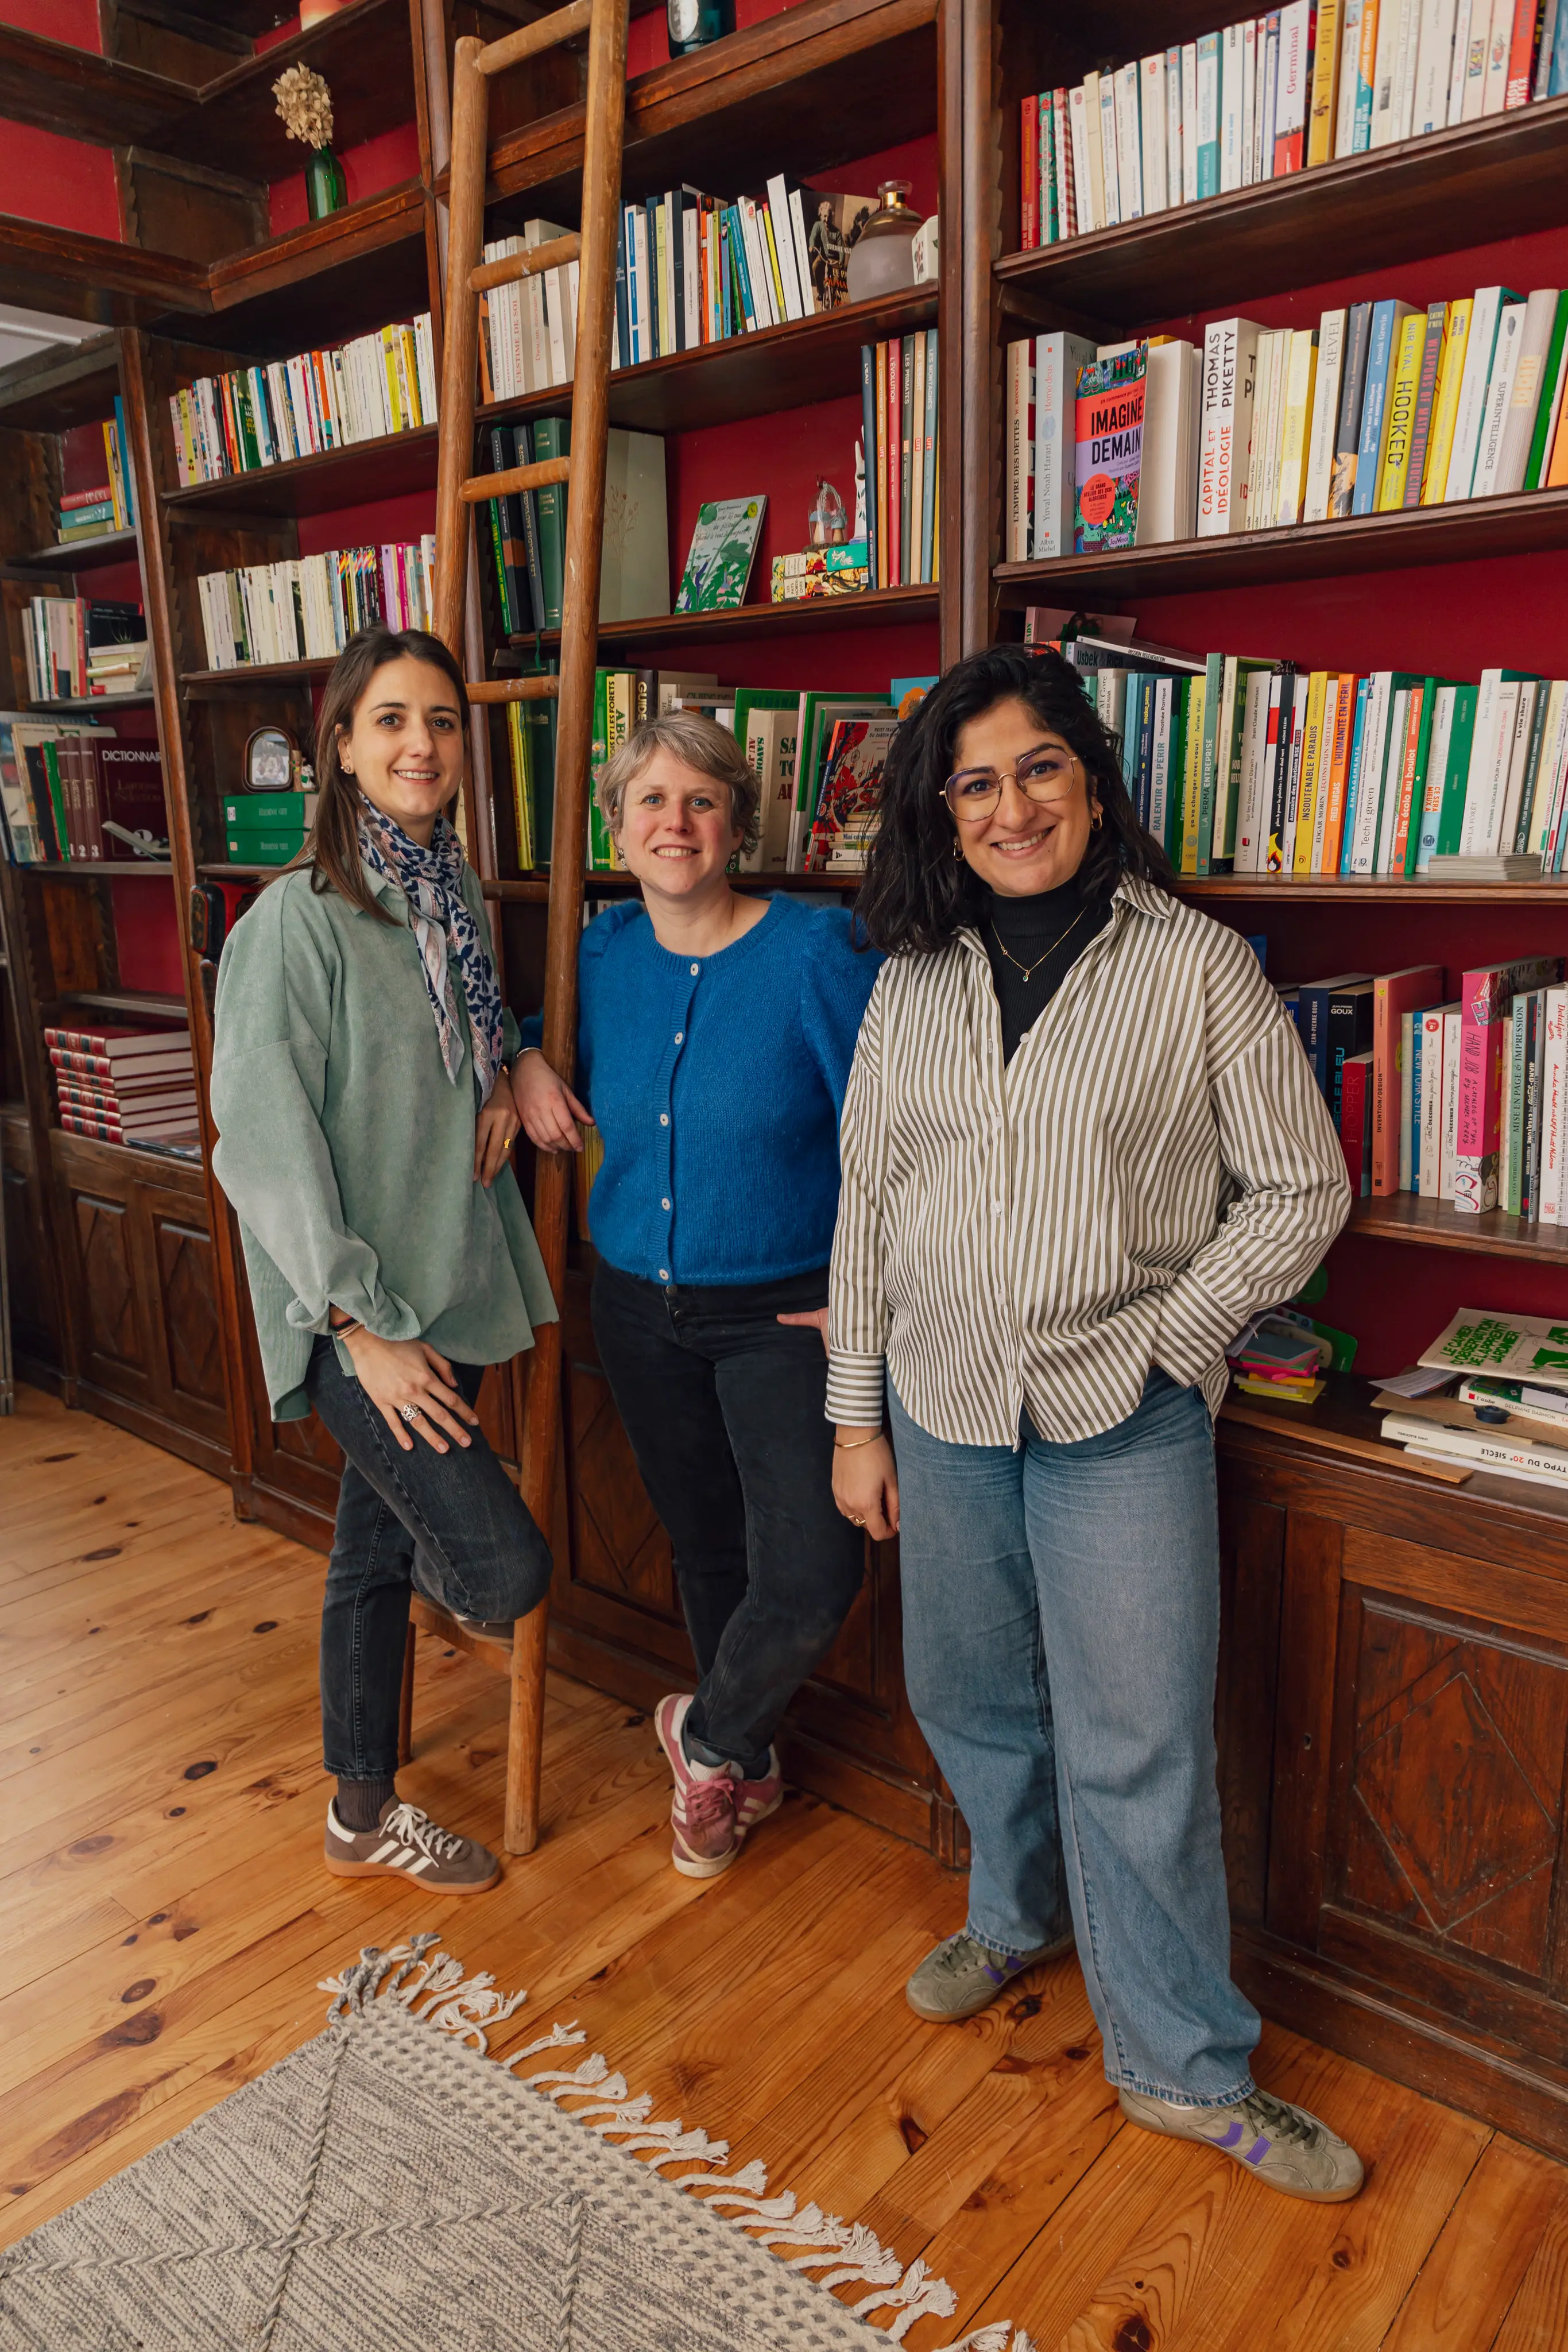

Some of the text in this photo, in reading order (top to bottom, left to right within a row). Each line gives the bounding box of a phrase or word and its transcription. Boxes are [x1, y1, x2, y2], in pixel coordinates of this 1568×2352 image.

[1286, 25, 1299, 94] Germinal
[514, 319, 520, 334] DE
[1326, 317, 1340, 366] REVEL
[1375, 314, 1388, 366] Anouk Grevin
[1206, 333, 1220, 411] THOMAS
[1222, 331, 1235, 408] PIKETTY
[1044, 365, 1053, 412] Homo deus
[1387, 323, 1416, 464] NIR EYAL HOOKED
[1485, 341, 1511, 470] SUPERINTELLIGENCE BOSTROM
[1091, 394, 1143, 436] IMAGINE
[1315, 378, 1331, 475] L'obsession anti-américaine
[1406, 338, 1438, 504] WEAPONS OF MATH DESTRUCTION
[1092, 426, 1141, 465] DEMAIN
[1043, 443, 1052, 521] Yuval Noah Harari
[1202, 430, 1216, 515] CAPITAL ET
[1216, 425, 1231, 513] IDÉOLOGIE
[523, 491, 532, 529] SAUVAGES
[526, 531, 535, 560] PARADIS
[1482, 678, 1493, 719] Jean Hegland
[1519, 698, 1527, 717] share
[616, 709, 625, 745] ABC
[1322, 725, 1332, 746] SIÈCLE
[1326, 715, 1332, 724] DE
[1306, 725, 1318, 759] PARADIS
[1330, 682, 1350, 821] FRED VARGAS L'HUMANITÉ EN PÉRIL
[1526, 762, 1534, 782] L'HISTOIRE
[1530, 733, 1539, 755] L'HUMANITÉ
[1321, 768, 1329, 792] LEÇONS
[1349, 746, 1360, 808] ENGAGEMENTS
[1404, 749, 1416, 778] boulot
[1152, 742, 1165, 830] RALENTIR OU PÉRIR
[1201, 738, 1213, 827] LA PERMAENTREPRISE
[1302, 762, 1314, 821] INSOUTENABLE
[1404, 780, 1412, 792] au
[1426, 787, 1434, 806] MIEUX
[1432, 787, 1441, 812] CE SERA
[1317, 796, 1325, 818] MORIN
[1365, 788, 1375, 815] green
[1399, 794, 1412, 817] écolo
[1468, 802, 1477, 834] LA FORÊT
[1315, 821, 1323, 843] EDGAR
[1361, 825, 1371, 846] Tech
[1397, 820, 1408, 837] Être
[79, 844, 99, 857] 2 3
[1515, 1006, 1524, 1061] IMPRESSION
[1335, 1047, 1344, 1084] BLEU
[1514, 1073, 1522, 1096] PAGE
[1344, 1077, 1360, 1138] HOPPER
[1514, 1098, 1521, 1110] EN
[1442, 1325, 1475, 1356] LE CAHIER
[1450, 1318, 1496, 1364] D'OBSERVATION
[1468, 1321, 1509, 1366] DE L'APPRENTI
[1489, 1330, 1521, 1363] JARDINIER
[1504, 1402, 1557, 1419] DELPHINE DARMON
[1481, 1448, 1507, 1459] SIÈCLE
[1543, 1463, 1567, 1473] TYPO
